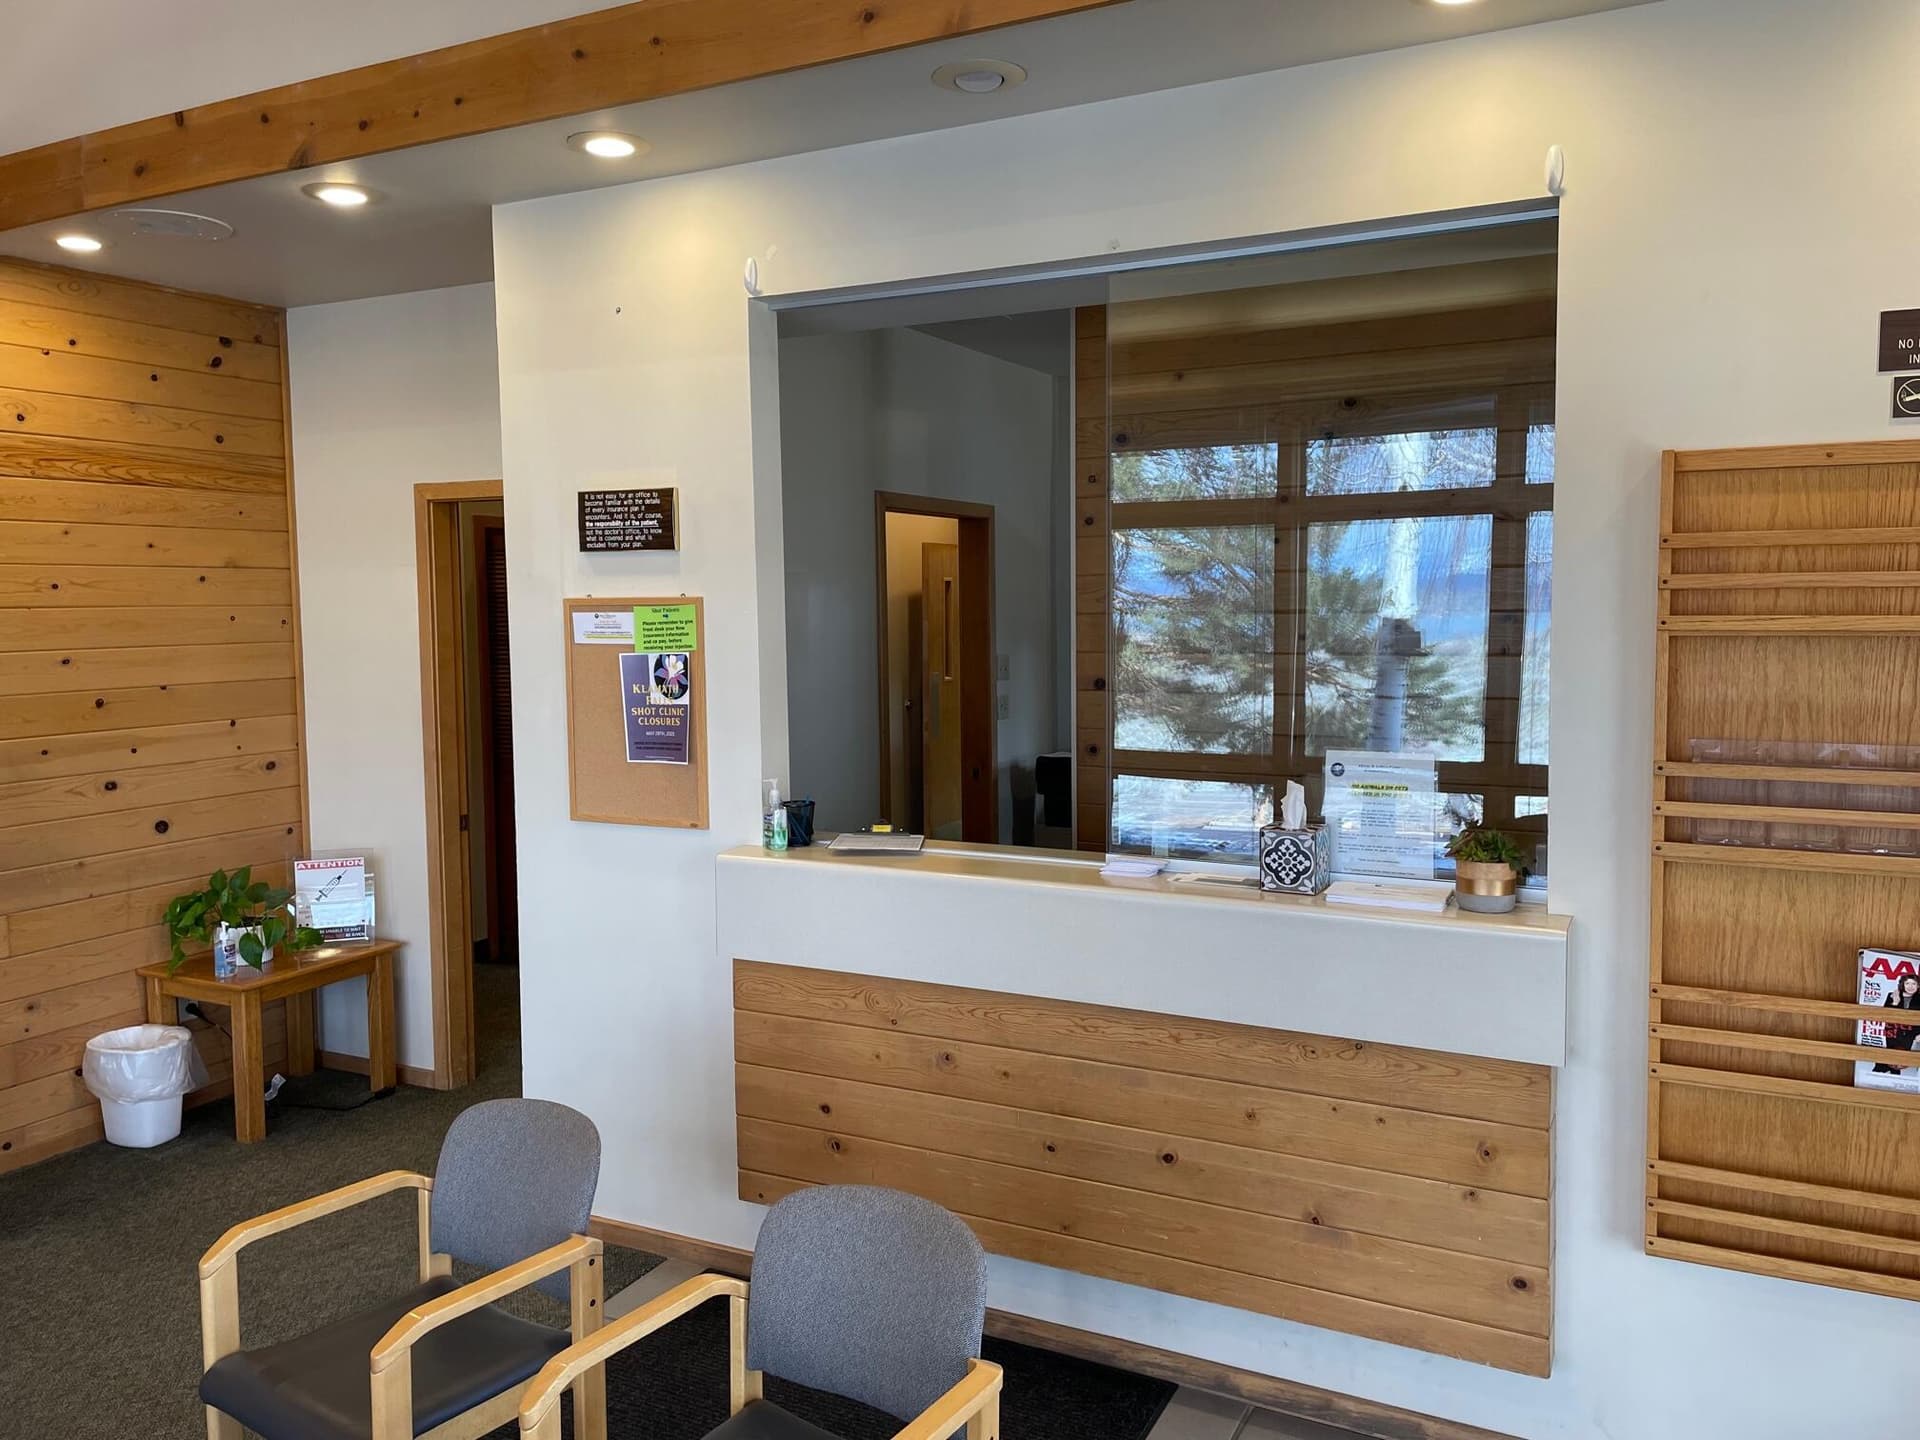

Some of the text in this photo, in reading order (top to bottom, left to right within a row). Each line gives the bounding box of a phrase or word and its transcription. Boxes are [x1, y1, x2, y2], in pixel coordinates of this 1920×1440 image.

[1898, 338, 1914, 349] NO
[632, 707, 685, 716] SHOT CLINIC
[638, 717, 680, 726] CLOSURES
[297, 860, 364, 869] ATTENTION
[1862, 957, 1920, 980] AA
